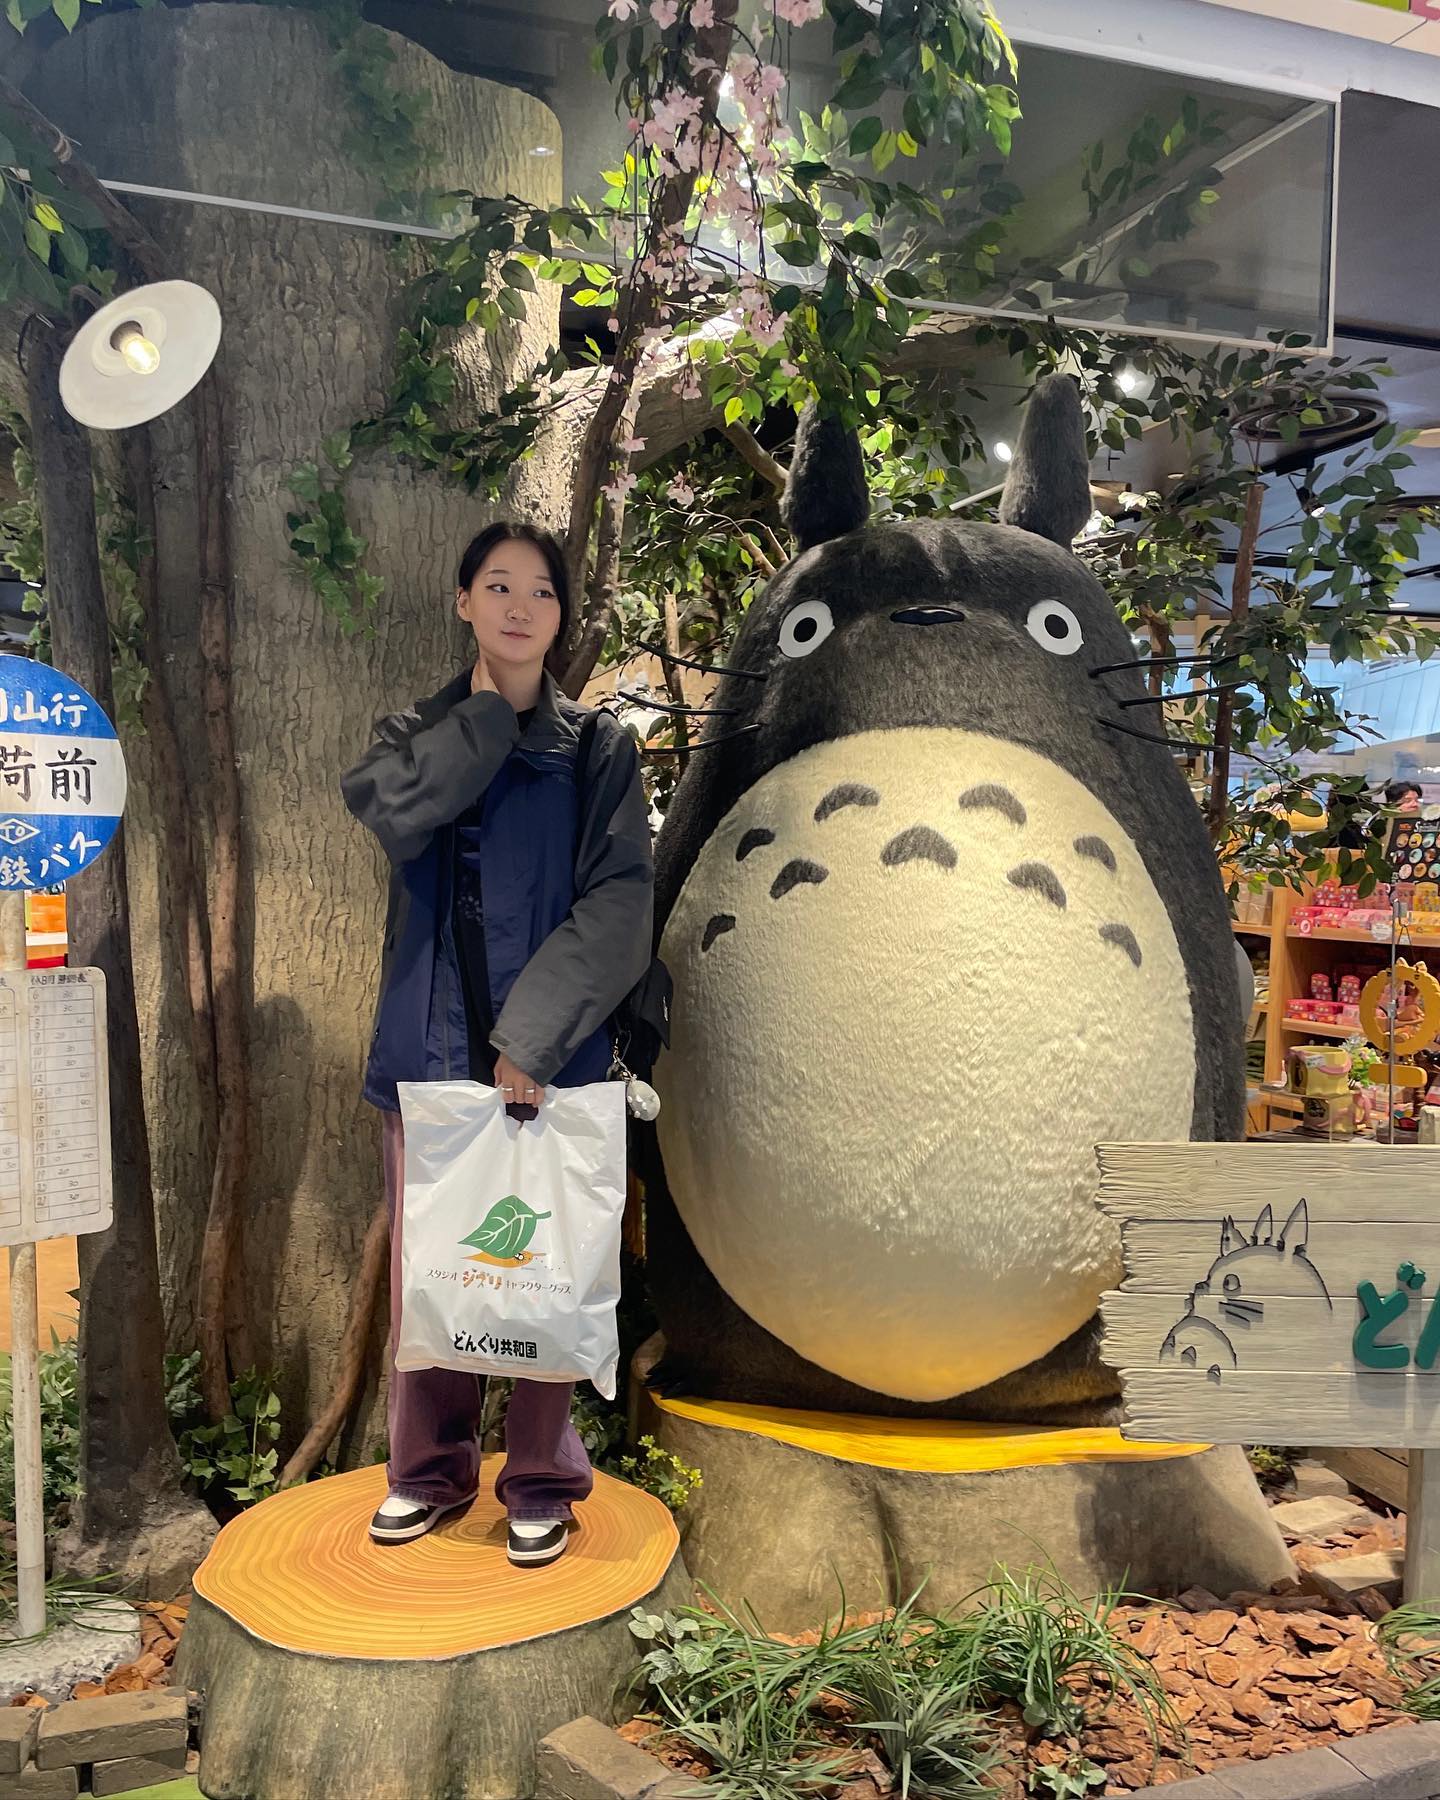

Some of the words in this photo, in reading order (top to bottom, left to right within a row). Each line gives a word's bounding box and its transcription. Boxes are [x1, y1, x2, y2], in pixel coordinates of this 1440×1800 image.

[0, 688, 88, 728] 山行
[1353, 1261, 1440, 1369] ど
[454, 1330, 537, 1359] どんぐり共和国
